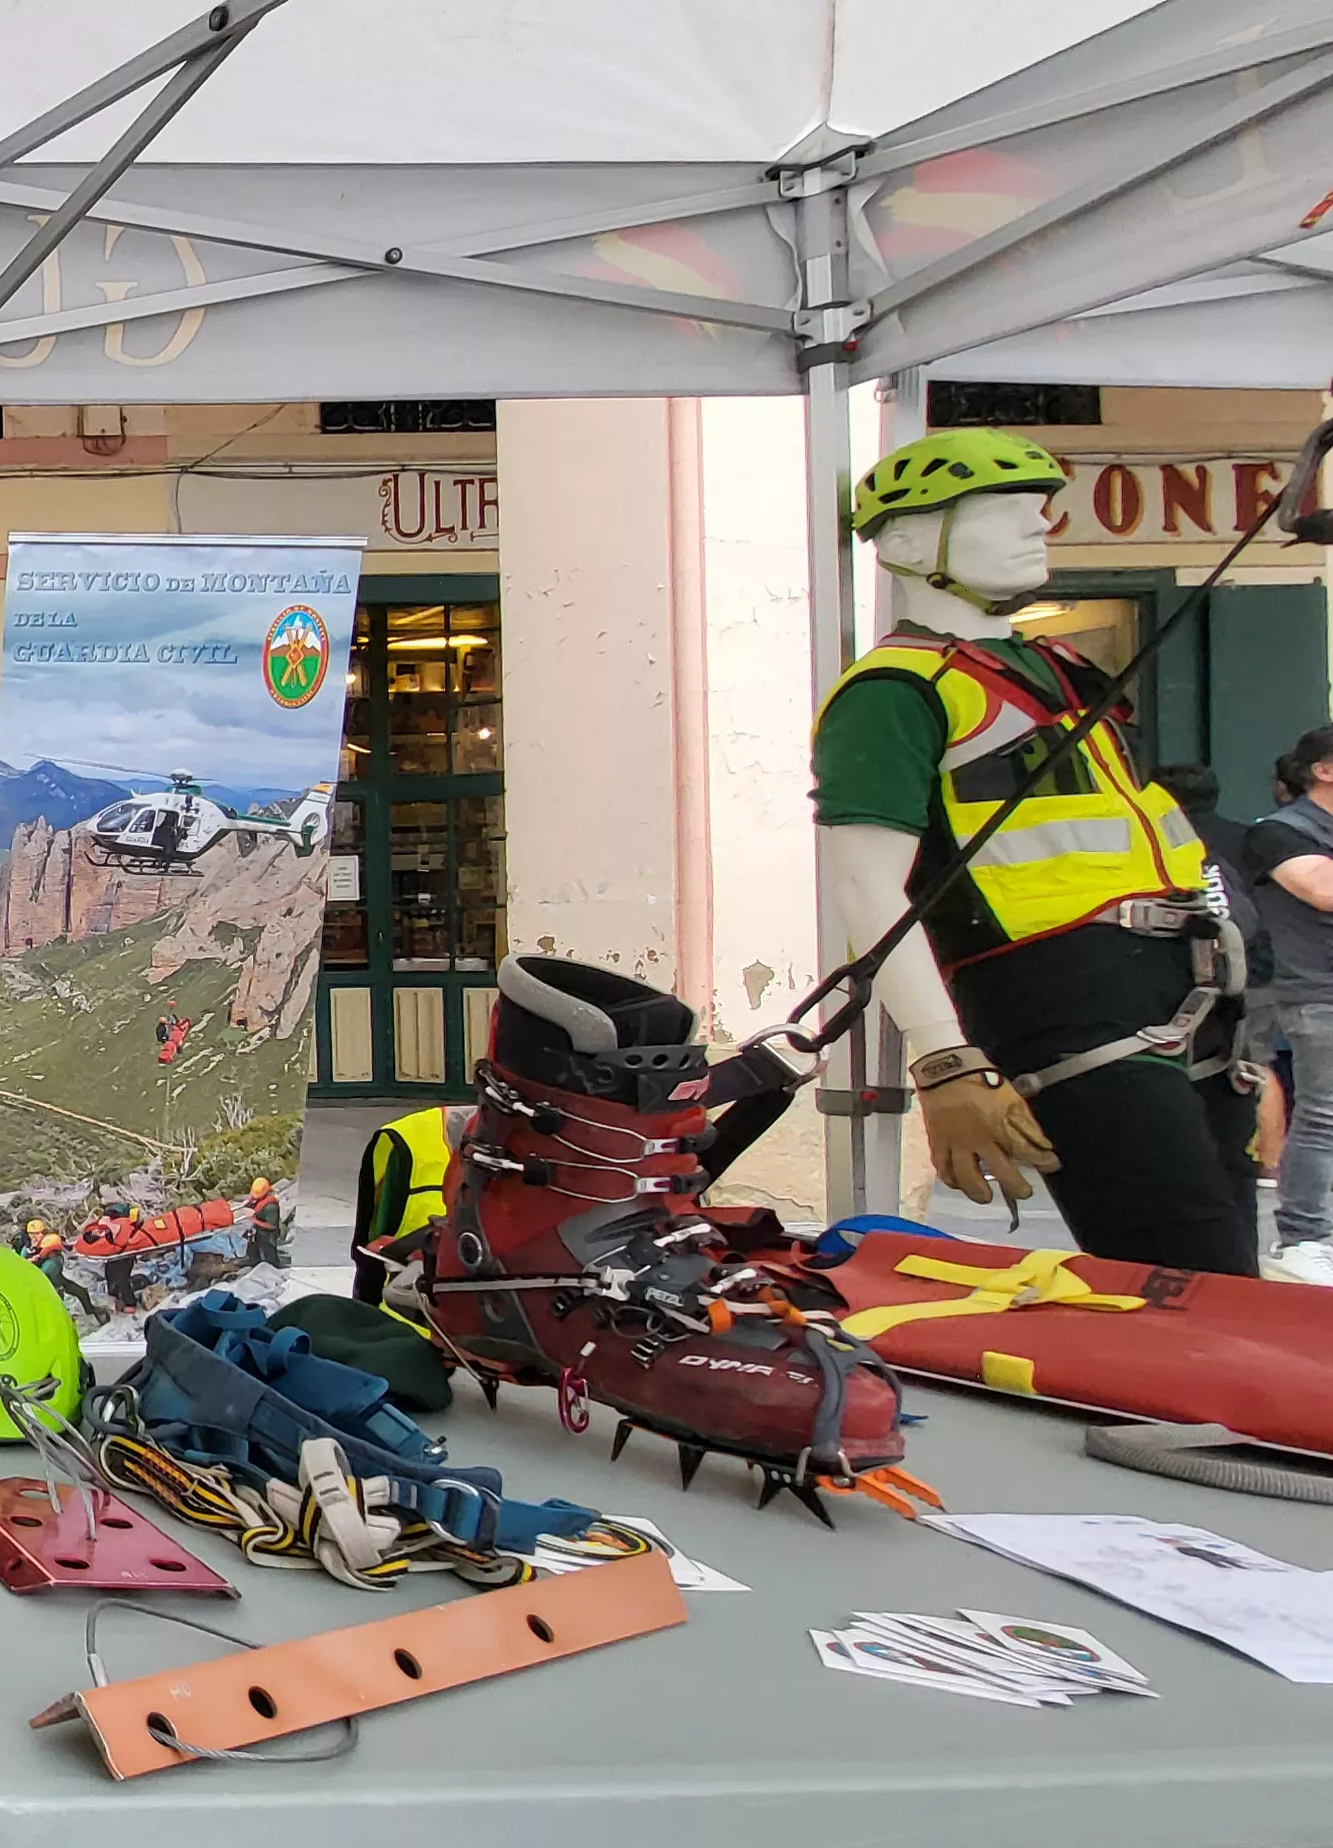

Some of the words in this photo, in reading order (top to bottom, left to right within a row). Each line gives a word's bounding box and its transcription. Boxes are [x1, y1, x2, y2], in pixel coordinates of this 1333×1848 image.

[16, 571, 161, 593] SERVICIO
[200, 568, 352, 595] MONTAÑA
[13, 611, 44, 627] DE
[47, 611, 77, 627] LA
[12, 642, 150, 664] GUARDIA
[157, 642, 238, 664] CIVIL
